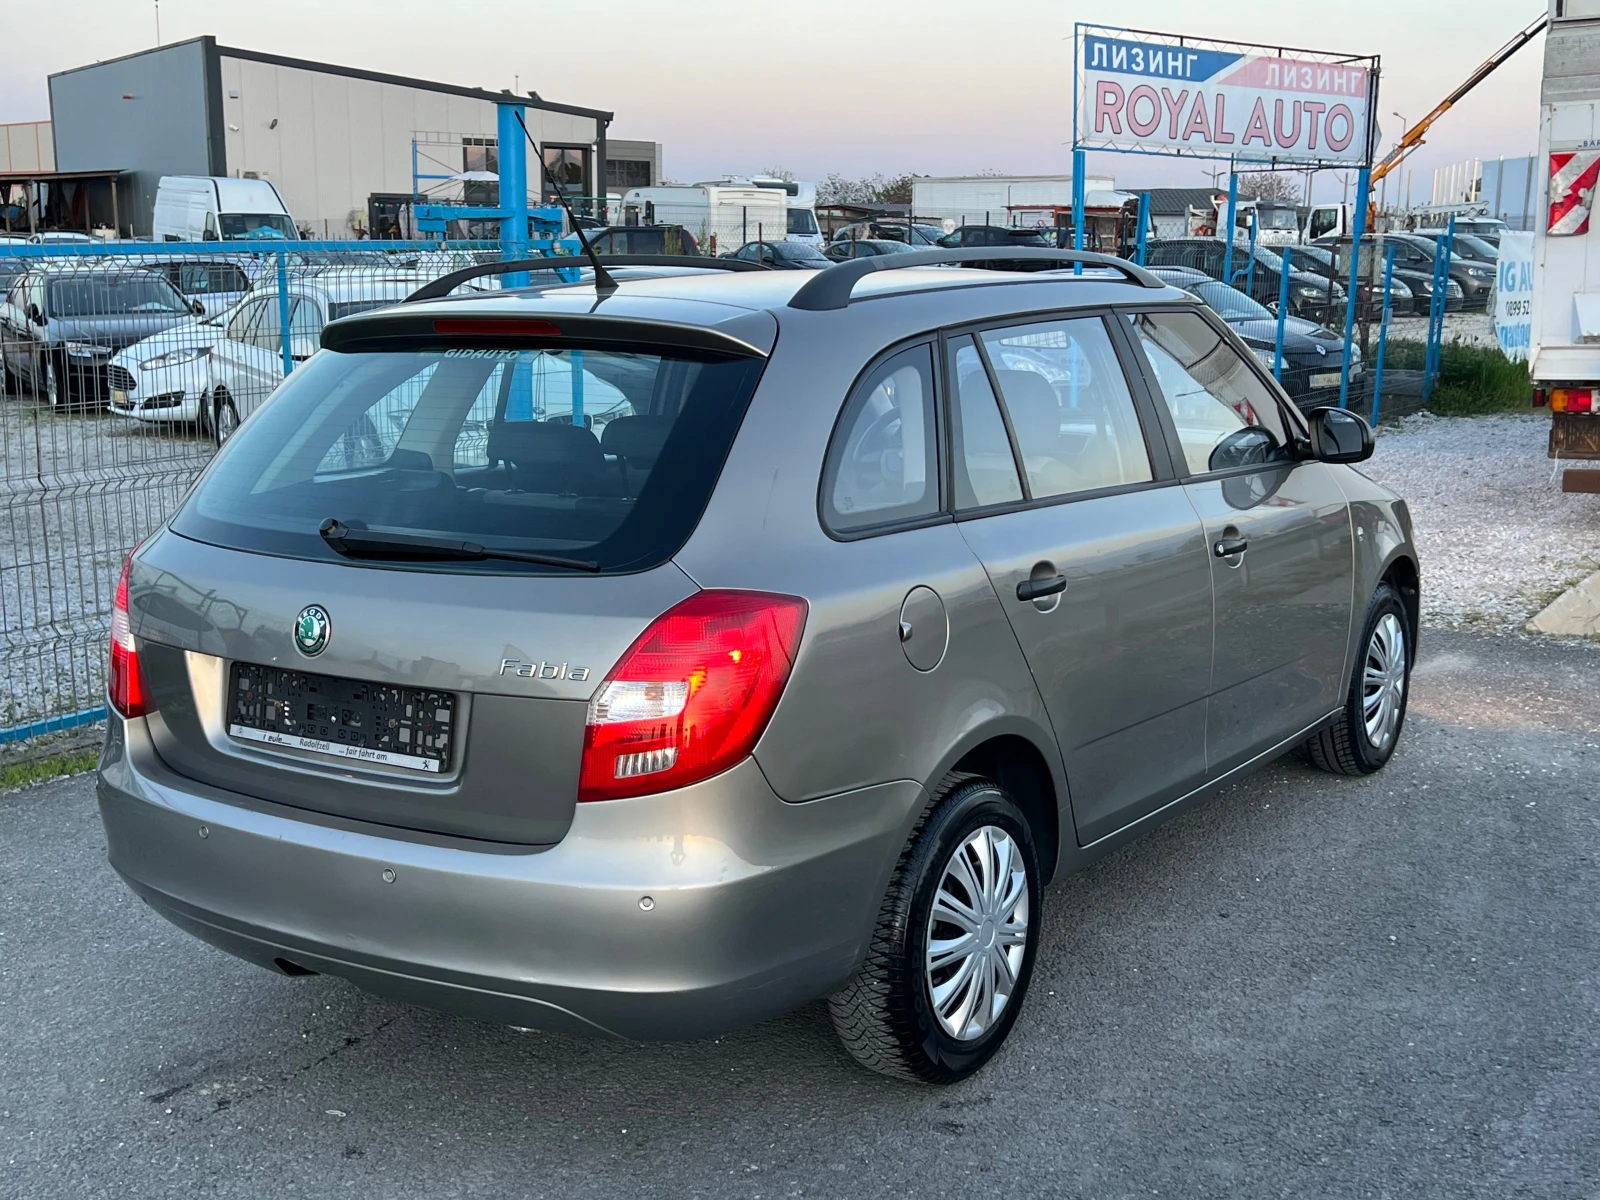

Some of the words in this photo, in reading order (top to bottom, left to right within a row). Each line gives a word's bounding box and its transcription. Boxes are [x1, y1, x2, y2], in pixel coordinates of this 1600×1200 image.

[1091, 42, 1198, 78] ЛИЗИНГ
[1265, 63, 1366, 93] ЛИЗИНГ
[1095, 80, 1235, 144] ROYAL
[1242, 96, 1355, 152] AUTO
[444, 349, 520, 360] GIDAUTO
[499, 658, 590, 681] Fabia
[299, 738, 330, 750] Radolfzell
